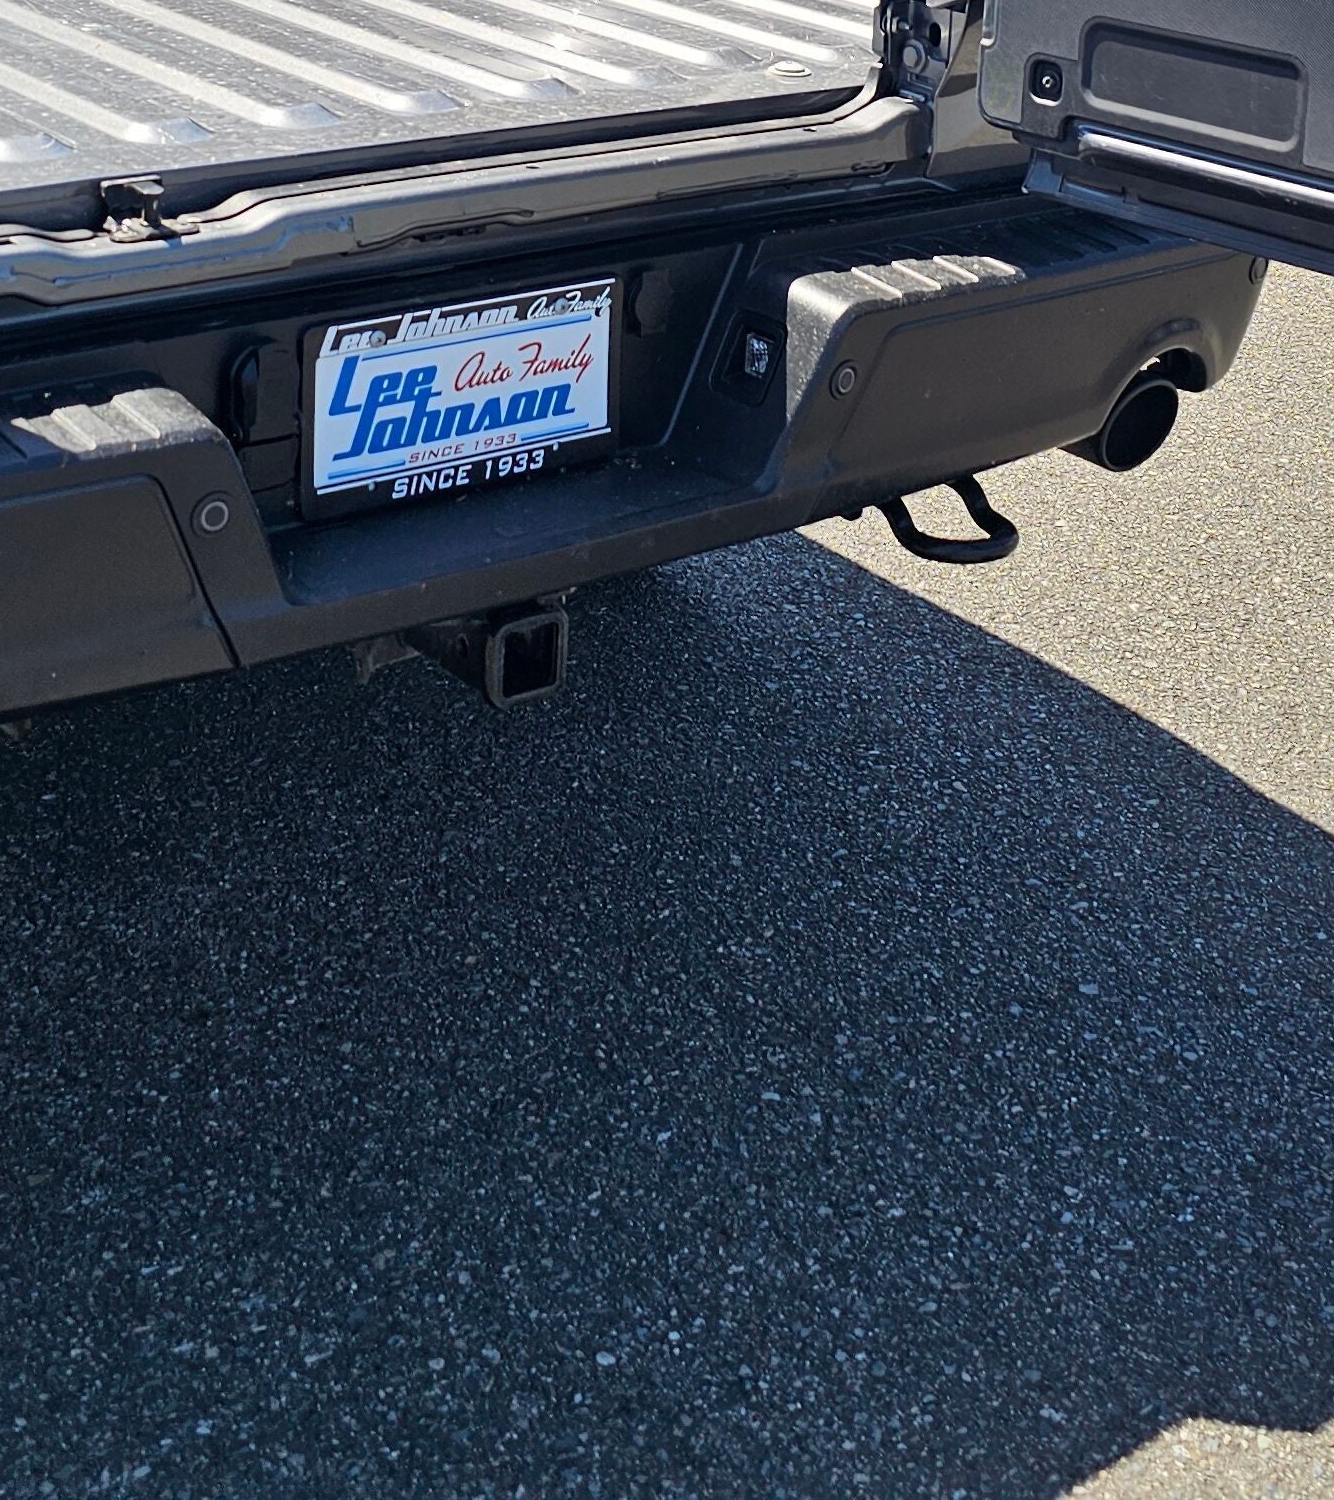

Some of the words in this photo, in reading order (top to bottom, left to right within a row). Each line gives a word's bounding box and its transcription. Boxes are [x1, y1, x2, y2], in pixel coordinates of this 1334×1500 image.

[387, 305, 519, 343] Johnson
[527, 296, 565, 320] Aut
[566, 286, 612, 317] Family
[328, 355, 438, 416] Lee
[454, 351, 513, 392] Auto
[518, 333, 594, 383] Family
[332, 383, 575, 461] Johnson
[408, 443, 465, 464] SINCE
[474, 433, 517, 451] 1933
[392, 464, 473, 499] SINCE
[485, 449, 545, 481] 1933
